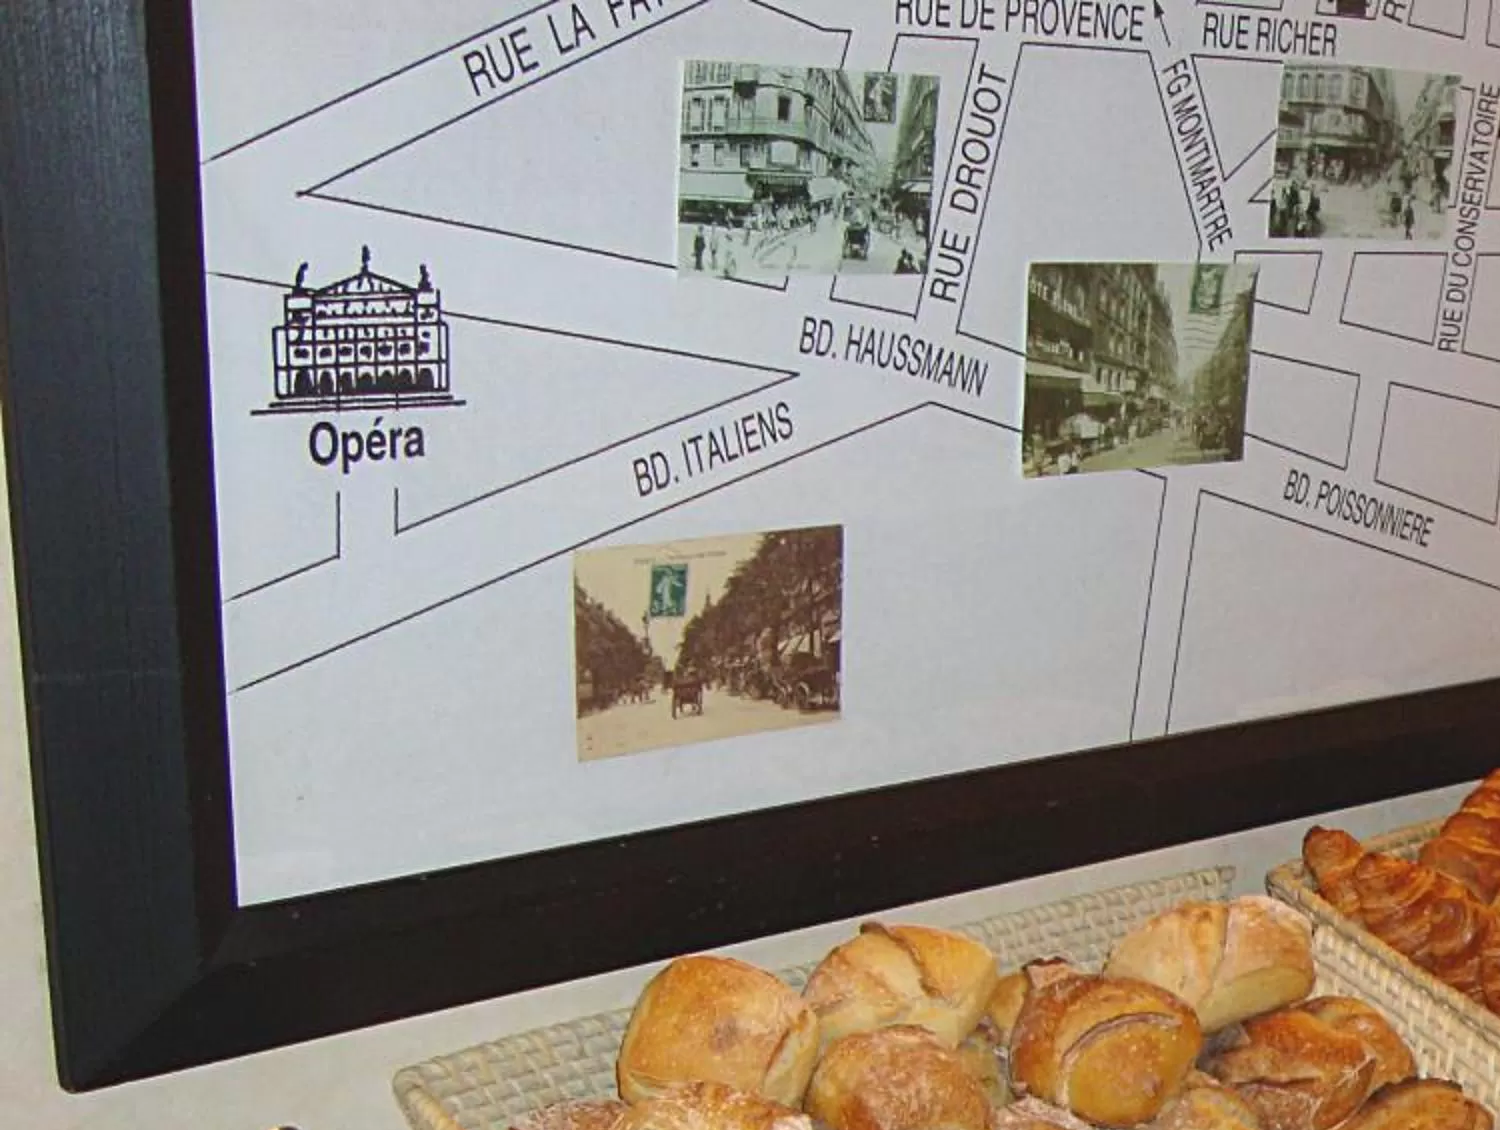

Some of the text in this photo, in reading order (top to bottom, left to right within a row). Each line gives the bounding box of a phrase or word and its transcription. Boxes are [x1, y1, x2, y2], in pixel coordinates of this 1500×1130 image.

[463, 27, 540, 96] RUE
[547, 3, 596, 54] LA
[894, 0, 1145, 42] RUE DE PROVENCE
[1203, 13, 1337, 57] RUE RICHER
[930, 63, 1007, 303] RUE DROUOT
[1162, 58, 1233, 253] FG MONTMARTRE
[1438, 82, 1500, 352] RUE DU CONSERVATOIRE
[799, 316, 836, 357] BD.
[845, 325, 988, 397] HAUSSMANN
[308, 416, 426, 474] Opéra
[633, 404, 794, 497] BD. ITALIENS
[1283, 469, 1436, 548] BD. POISSONNIERE
